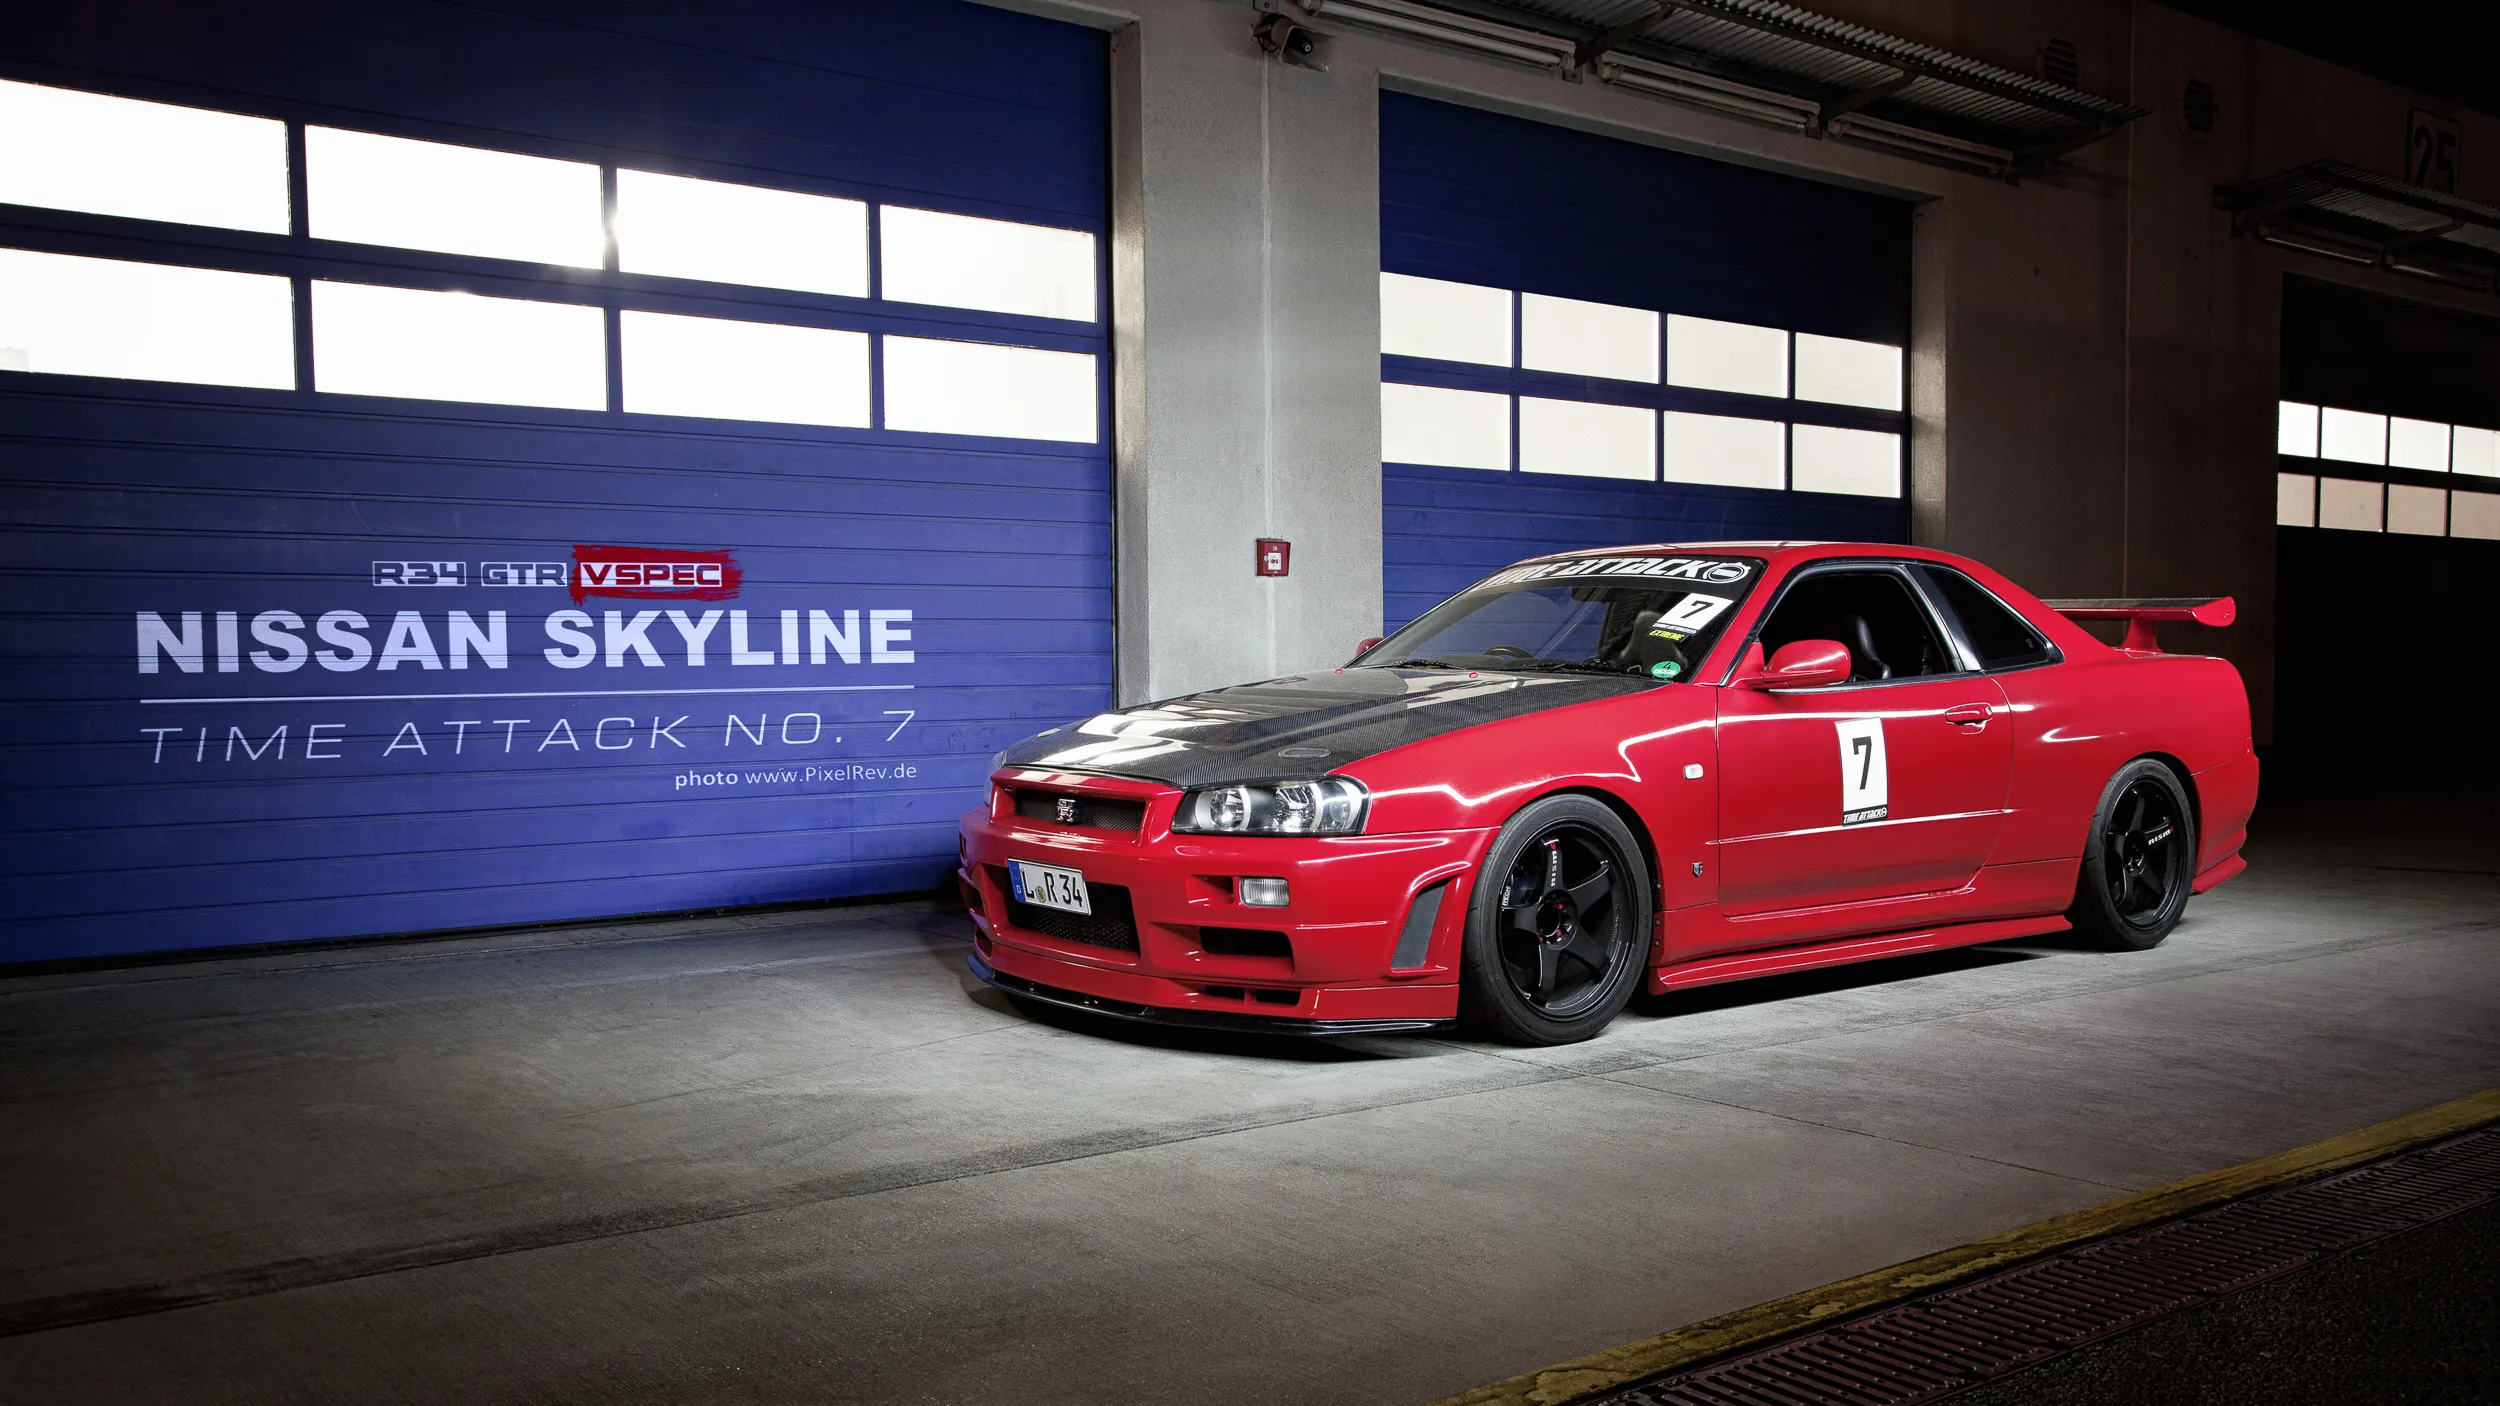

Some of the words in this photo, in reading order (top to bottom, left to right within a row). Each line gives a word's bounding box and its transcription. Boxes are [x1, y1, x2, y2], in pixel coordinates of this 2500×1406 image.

[2412, 124, 2456, 194] 25
[1680, 600, 1714, 619] 7
[1662, 662, 1672, 670] 4
[1852, 735, 1873, 790] 7
[1021, 867, 1035, 899] L
[1043, 871, 1059, 903] R
[1059, 873, 1083, 908] 34
